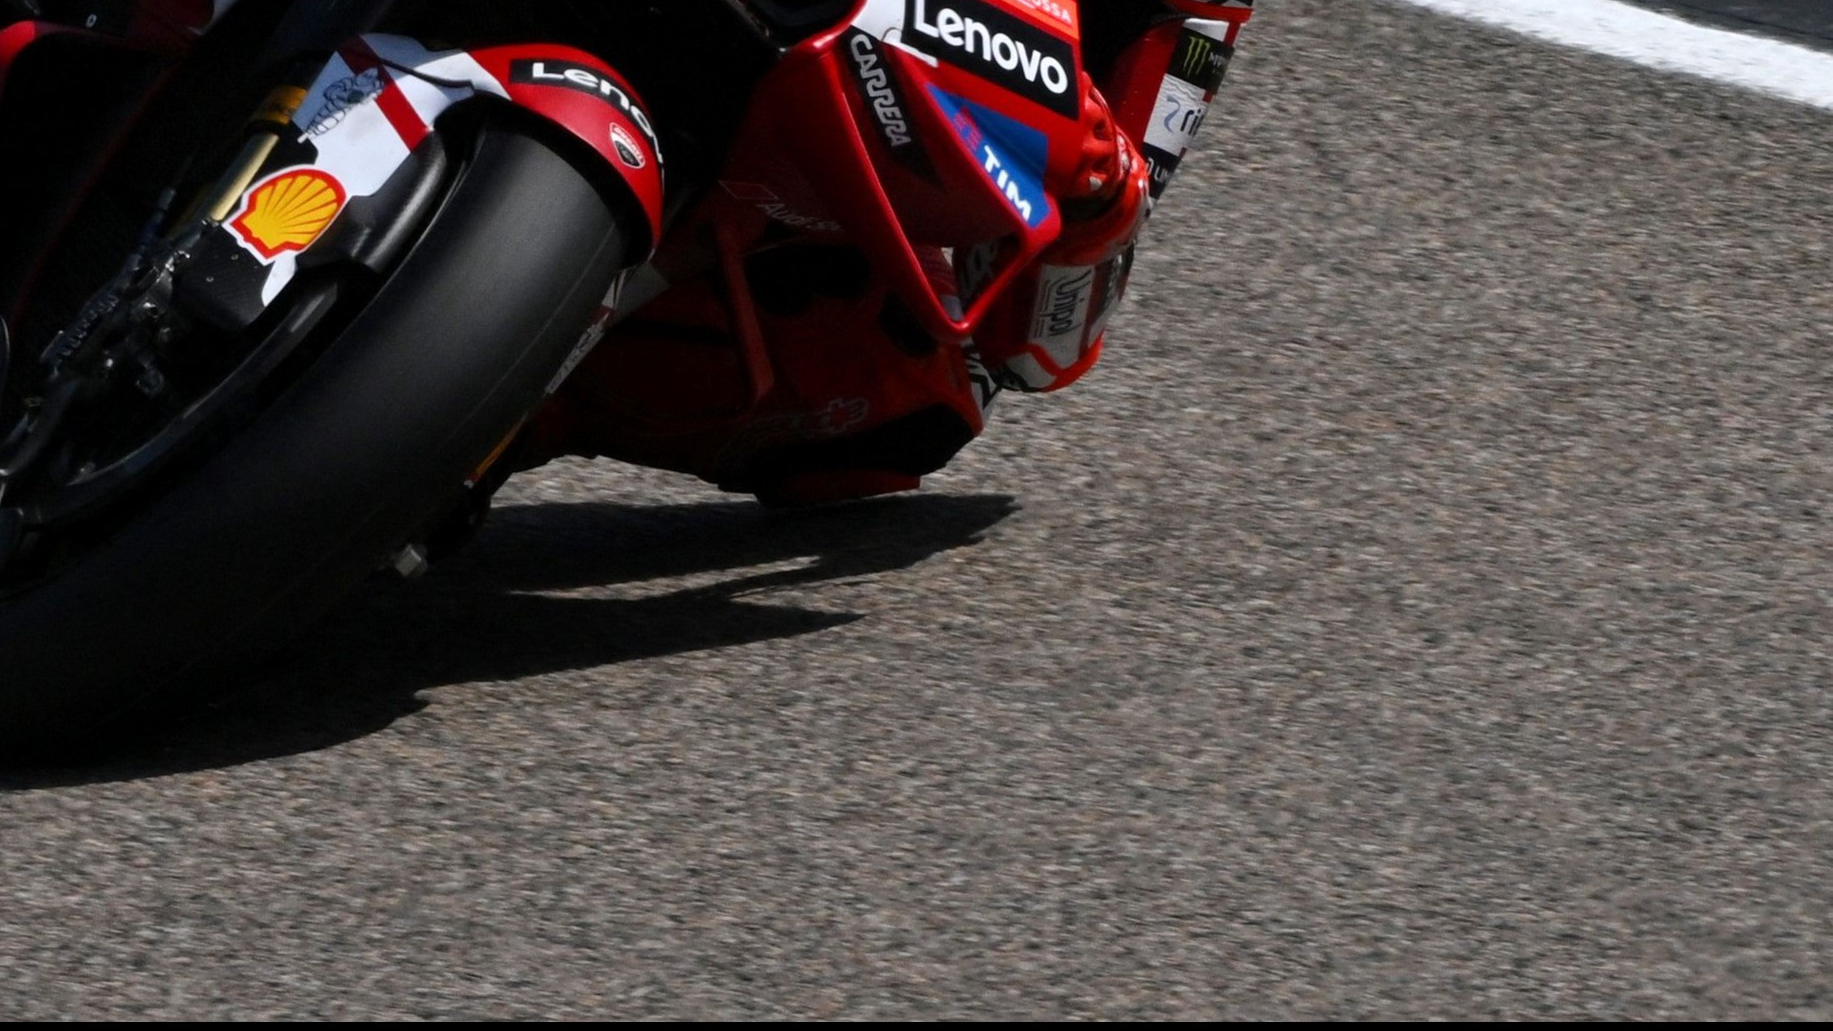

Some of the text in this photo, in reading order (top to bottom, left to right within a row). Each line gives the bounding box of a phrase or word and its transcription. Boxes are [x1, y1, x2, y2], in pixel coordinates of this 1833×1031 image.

[532, 62, 664, 164] Lenov
[850, 33, 912, 147] CARRERA
[983, 145, 1033, 221] TIM
